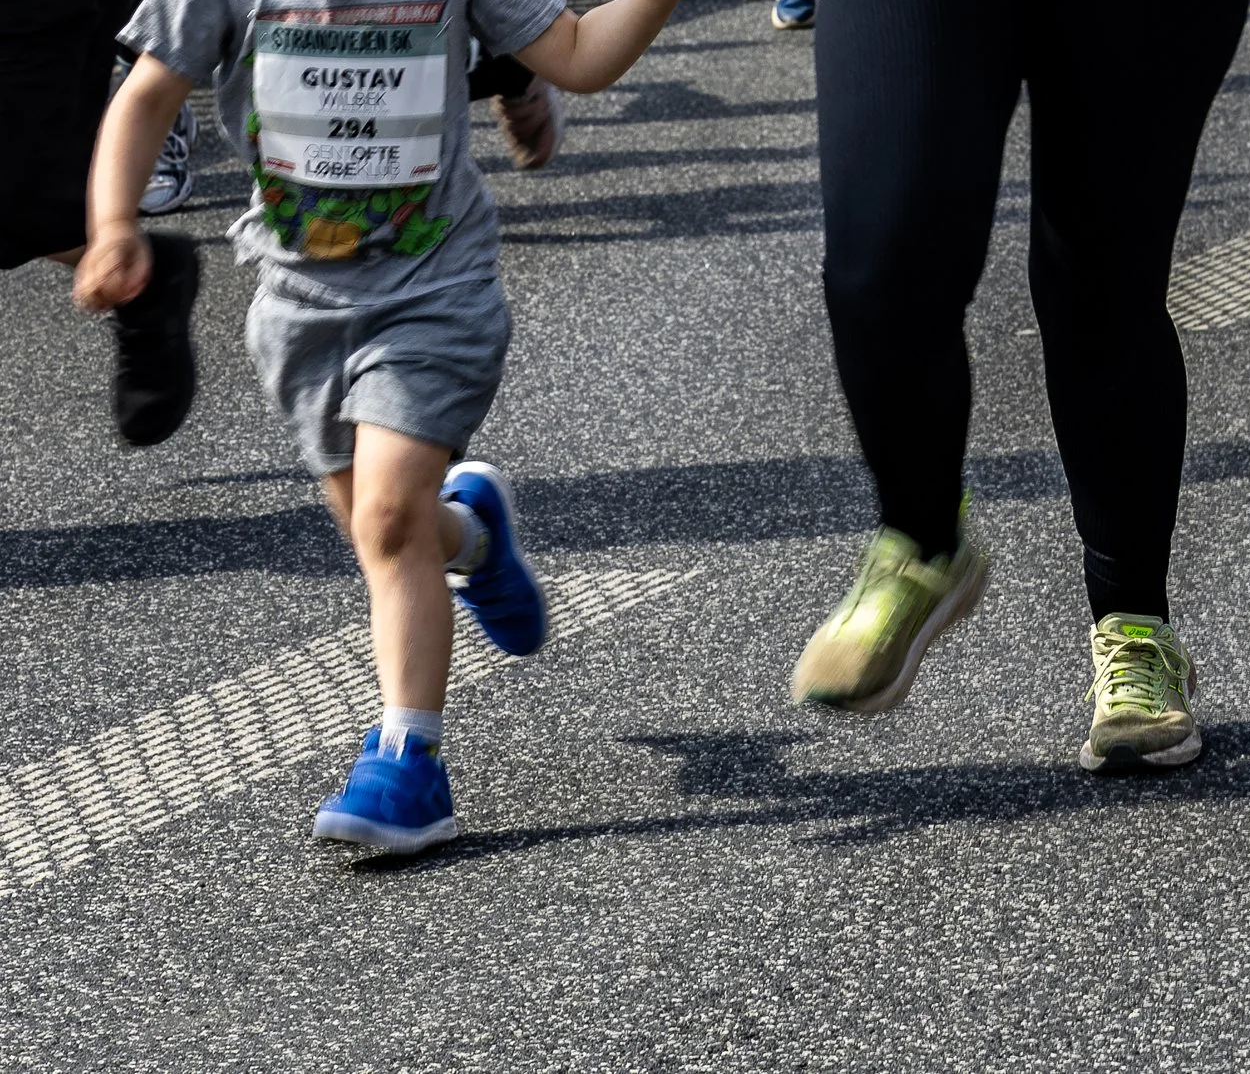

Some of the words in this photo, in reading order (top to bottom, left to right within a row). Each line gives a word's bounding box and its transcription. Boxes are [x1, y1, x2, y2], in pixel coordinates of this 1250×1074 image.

[301, 67, 406, 90] GUSTAV
[319, 90, 387, 109] WILBEK
[328, 117, 379, 139] 294
[305, 143, 400, 161] GENTOFTE
